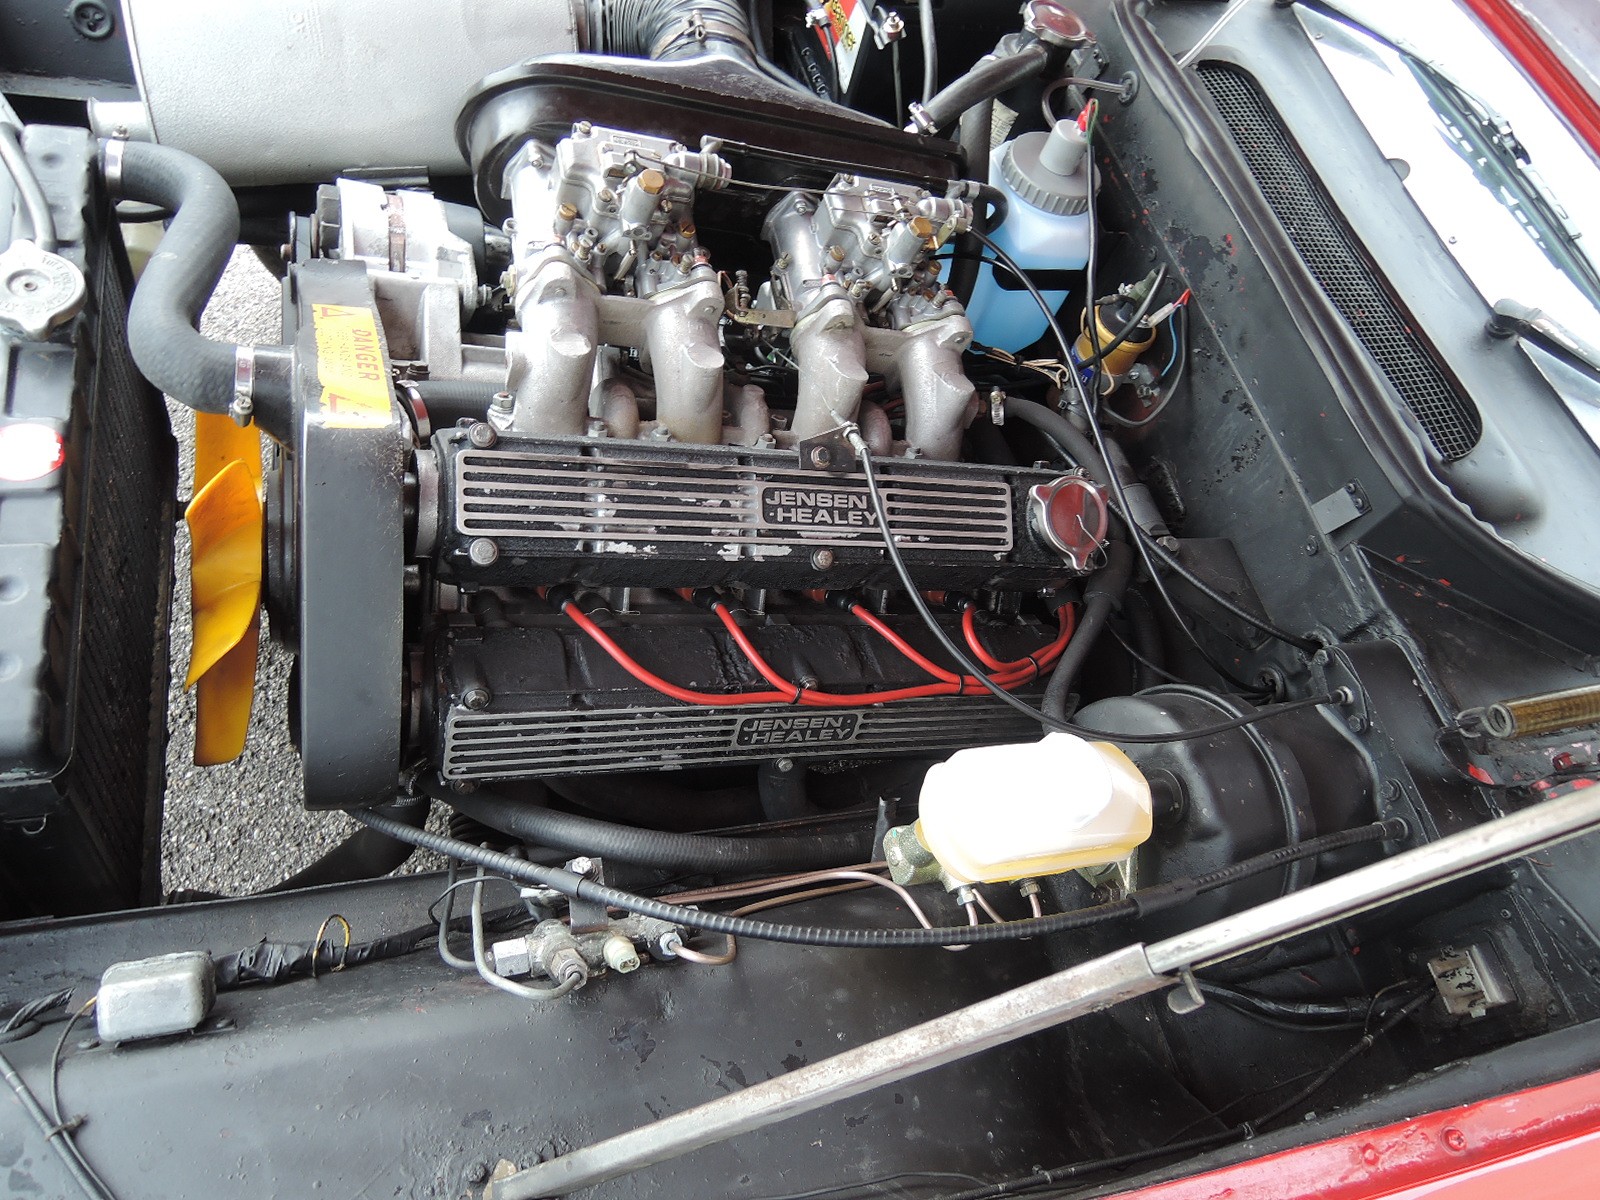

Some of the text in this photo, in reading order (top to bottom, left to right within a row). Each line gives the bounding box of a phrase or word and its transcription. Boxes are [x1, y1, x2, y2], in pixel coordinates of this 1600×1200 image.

[352, 328, 381, 381] DANGER
[766, 490, 867, 509] JENSEN
[777, 507, 877, 525] HEALEY
[743, 716, 844, 732] JENSEN
[750, 728, 851, 744] HEALEY
